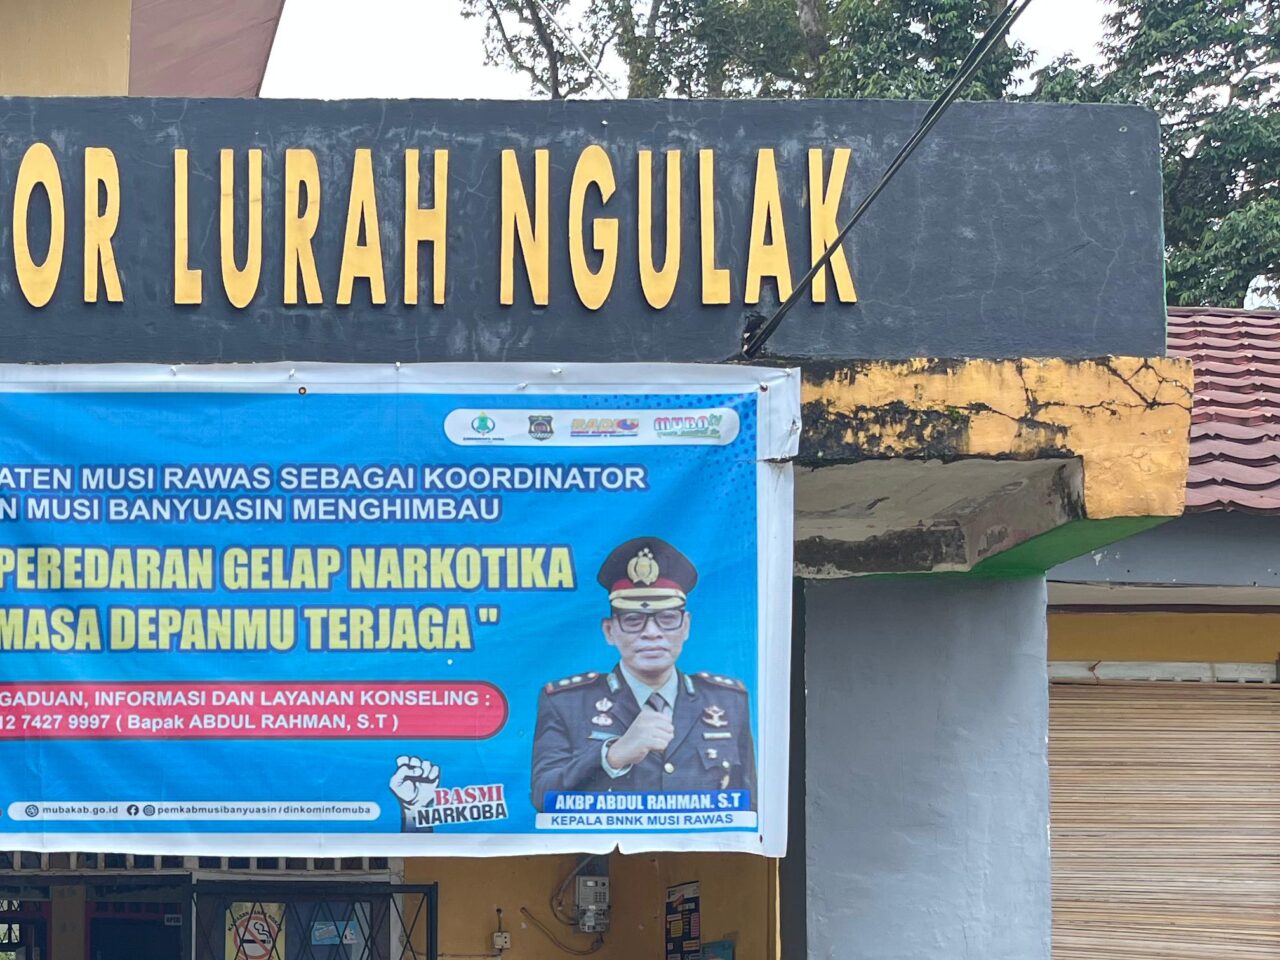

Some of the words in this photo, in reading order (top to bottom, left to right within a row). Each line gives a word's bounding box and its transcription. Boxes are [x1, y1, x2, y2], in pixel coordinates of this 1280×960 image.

[174, 148, 449, 308] LURAH
[500, 144, 857, 310] NGULAK
[82, 467, 154, 490] MUSI
[163, 467, 271, 490] RAWAS
[280, 467, 414, 490] SEBAGAI
[424, 467, 646, 489] KOORDINATOR
[27, 498, 99, 521] MUSI
[109, 498, 283, 521] BANYUASIN
[293, 498, 500, 520] MENGHIMBAU
[222, 547, 341, 590] GELAP
[350, 547, 575, 590] NARKOTIKA
[110, 607, 295, 651] DEPANMU
[95, 690, 206, 707] INFORMASI
[211, 690, 255, 706] DAN
[260, 690, 355, 706] LAYANAN
[360, 690, 479, 706] KONSELING
[21, 714, 62, 729] 7427
[68, 714, 111, 729] 9997
[127, 714, 184, 732] Bapak
[188, 714, 256, 729] ABDUL
[260, 714, 351, 732] RAHMAN,
[356, 714, 387, 729] S.T
[433, 785, 503, 807] BASMI
[555, 794, 595, 811] AKBP
[596, 794, 646, 810] ABDUL
[718, 792, 742, 809] S.T
[42, 805, 118, 817] mubakab.go.id
[416, 802, 507, 826] NARKOBA
[551, 815, 603, 827] KEPALA
[606, 815, 644, 826] BNNK
[646, 815, 680, 825] MUSI
[683, 814, 734, 825] RAWAS
